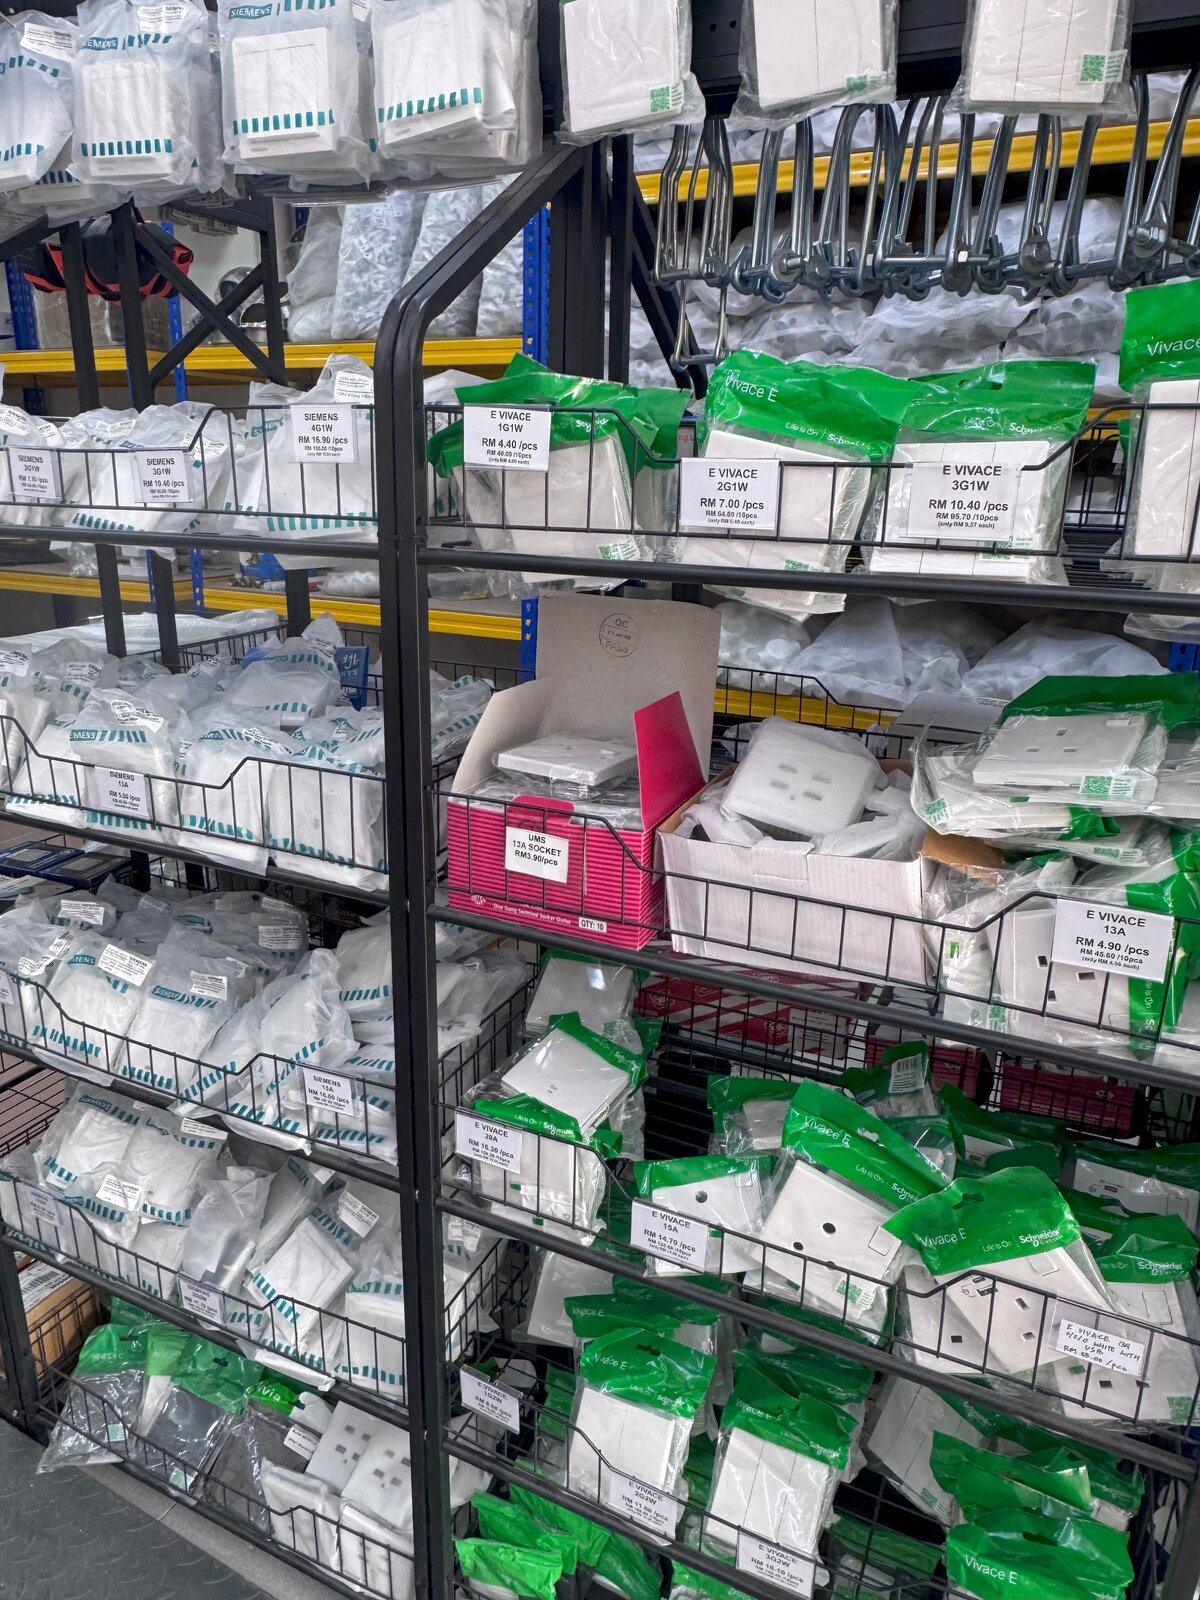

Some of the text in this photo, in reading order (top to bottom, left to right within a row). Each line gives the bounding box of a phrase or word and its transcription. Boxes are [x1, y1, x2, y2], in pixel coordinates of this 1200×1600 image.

[725, 371, 779, 403] Vivace E
[304, 413, 339, 421] SIEMENS
[499, 411, 531, 421] VIVACE
[311, 424, 333, 432] 4G1W
[498, 423, 523, 432] 1G1W
[298, 435, 348, 445] RM 16.90 /pcs
[482, 438, 538, 451] RM 4.40 /pcs
[18, 455, 43, 464] SIEMENS
[146, 458, 175, 466] SIEMENS
[709, 468, 758, 479] E VIVACE
[943, 465, 1002, 476] E VIVACE
[717, 482, 748, 492] 2G1W
[952, 480, 989, 491] 3G1W
[700, 498, 764, 512] RM 7.00 /pcs
[929, 499, 1009, 513] RM 10.40 /pcs
[736, 511, 758, 520] /10pcs
[973, 514, 999, 522] /10pcs
[528, 834, 546, 843] UMS
[512, 840, 562, 857] 13A SOCKET
[1086, 910, 1147, 927] E VIVACE
[581, 920, 604, 931] QTY: 10
[1104, 925, 1126, 936] 13A
[1076, 936, 1150, 957] RM 4.90 /pcs
[1117, 954, 1144, 964] /10pcs
[481, 1123, 509, 1137] VIVACE
[804, 1115, 840, 1140] Vivace
[468, 1138, 479, 1148] RM
[485, 1133, 498, 1143] 20A
[652, 1210, 691, 1229] E VIVACE
[663, 1222, 679, 1234] 15A
[643, 1228, 656, 1239] RM
[679, 1241, 696, 1253] /pcs
[920, 1228, 968, 1247] Vivace E
[1019, 1229, 1060, 1245] Schneider
[1078, 1328, 1111, 1342] VIVACE
[635, 1485, 664, 1502] VIVACE
[766, 1546, 798, 1565] VIVACE
[965, 1554, 1018, 1585] Vivace E
